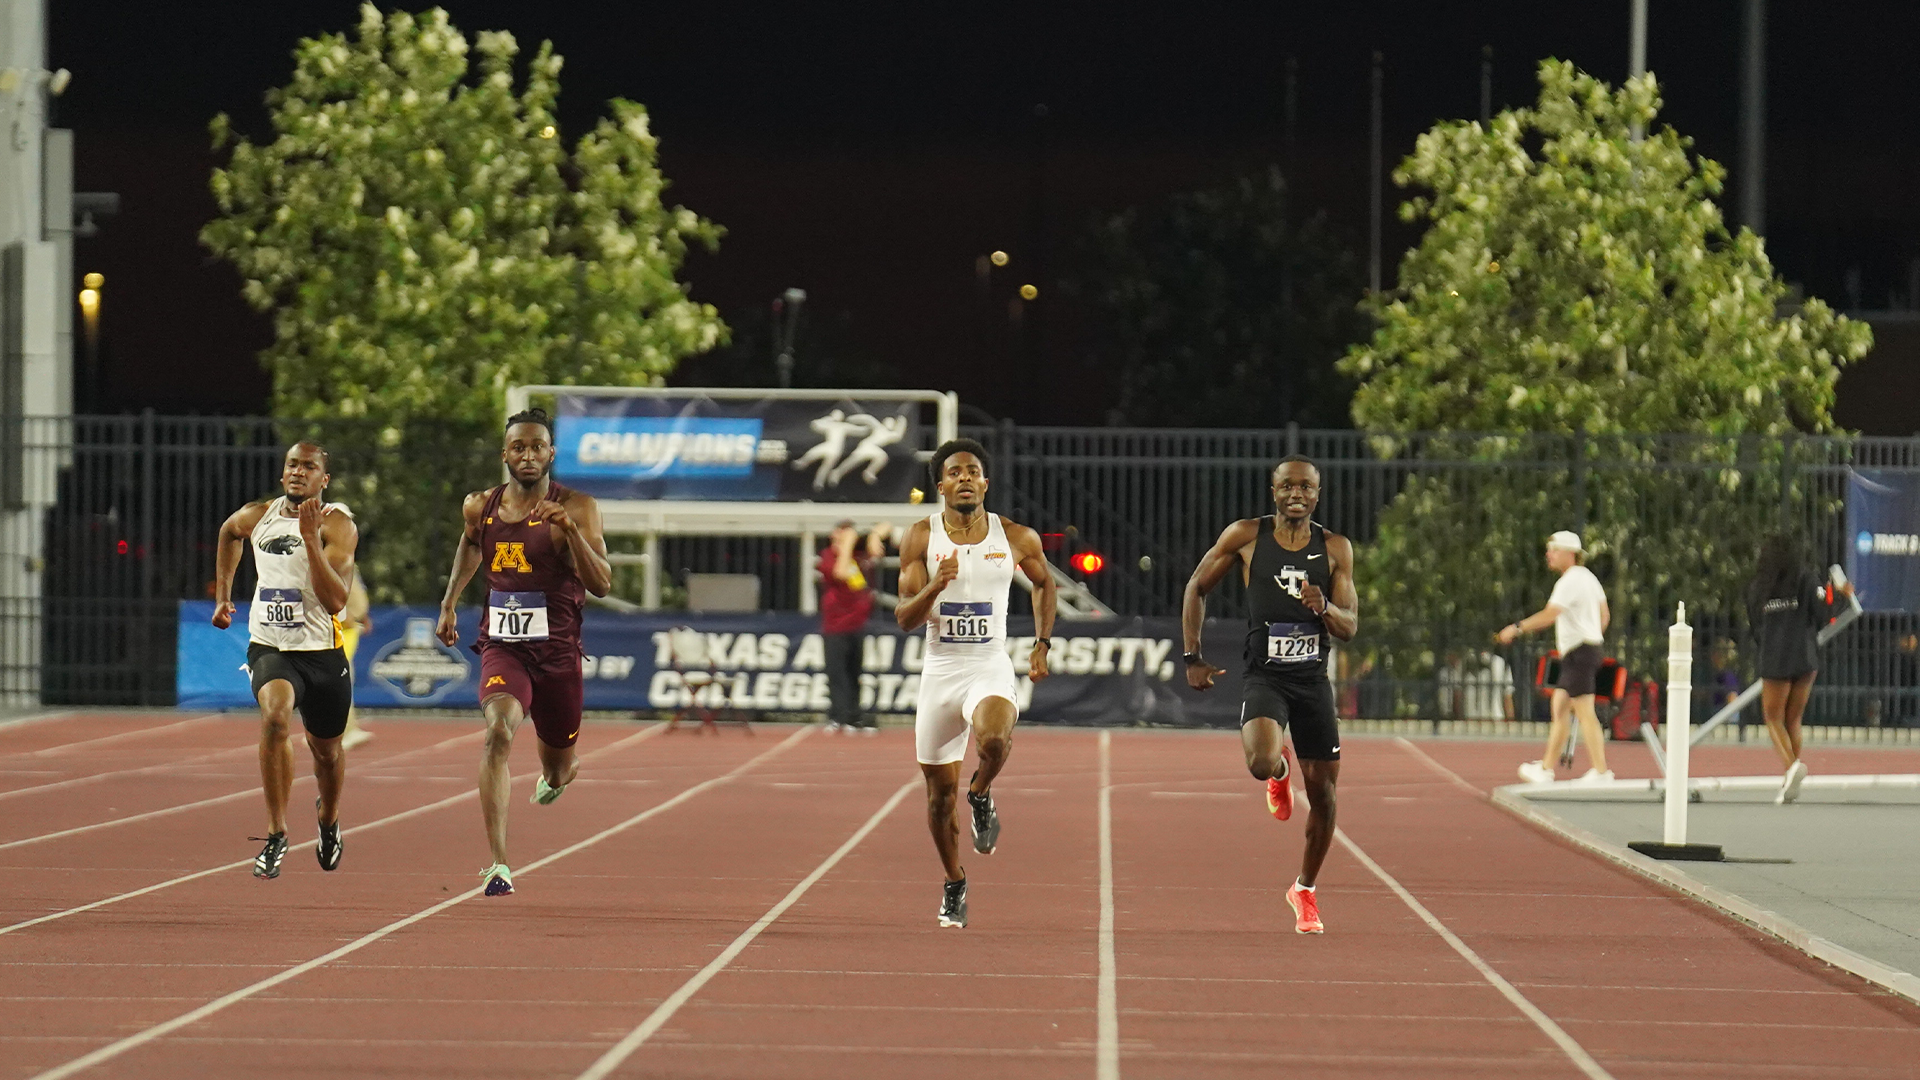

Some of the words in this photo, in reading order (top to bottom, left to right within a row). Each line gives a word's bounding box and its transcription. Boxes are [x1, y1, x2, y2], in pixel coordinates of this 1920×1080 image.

[578, 432, 756, 466] CHAMPIONS
[266, 604, 294, 622] 680
[497, 612, 534, 635] 707
[946, 618, 988, 636] 1616
[651, 631, 791, 671] TXAS
[791, 633, 897, 673] AM
[901, 634, 1175, 682] UERSITY,
[1274, 637, 1316, 657] 1228
